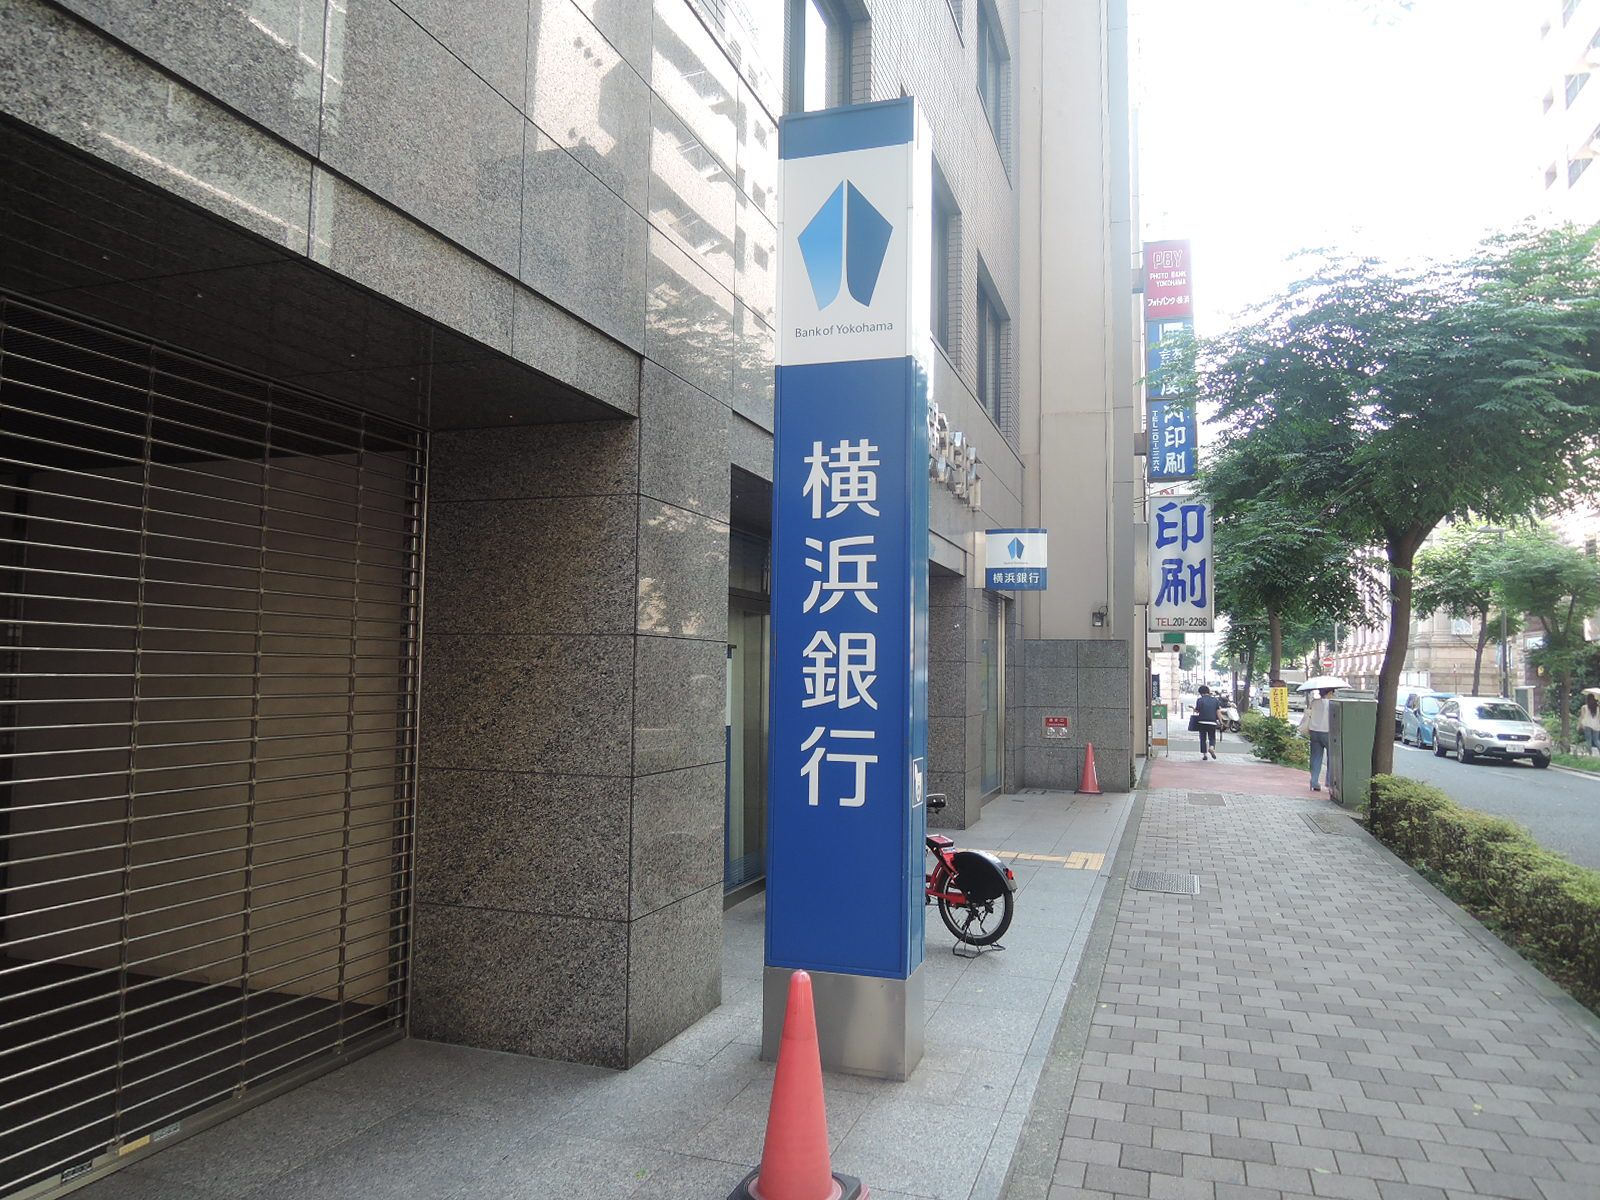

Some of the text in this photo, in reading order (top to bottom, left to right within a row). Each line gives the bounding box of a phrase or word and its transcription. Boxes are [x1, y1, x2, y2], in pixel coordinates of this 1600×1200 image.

[795, 322, 893, 338] Bank of Yokohama
[993, 572, 1039, 584] 横浜銀行
[1155, 502, 1207, 608] 印刷
[800, 438, 881, 808] 横浜銀行
